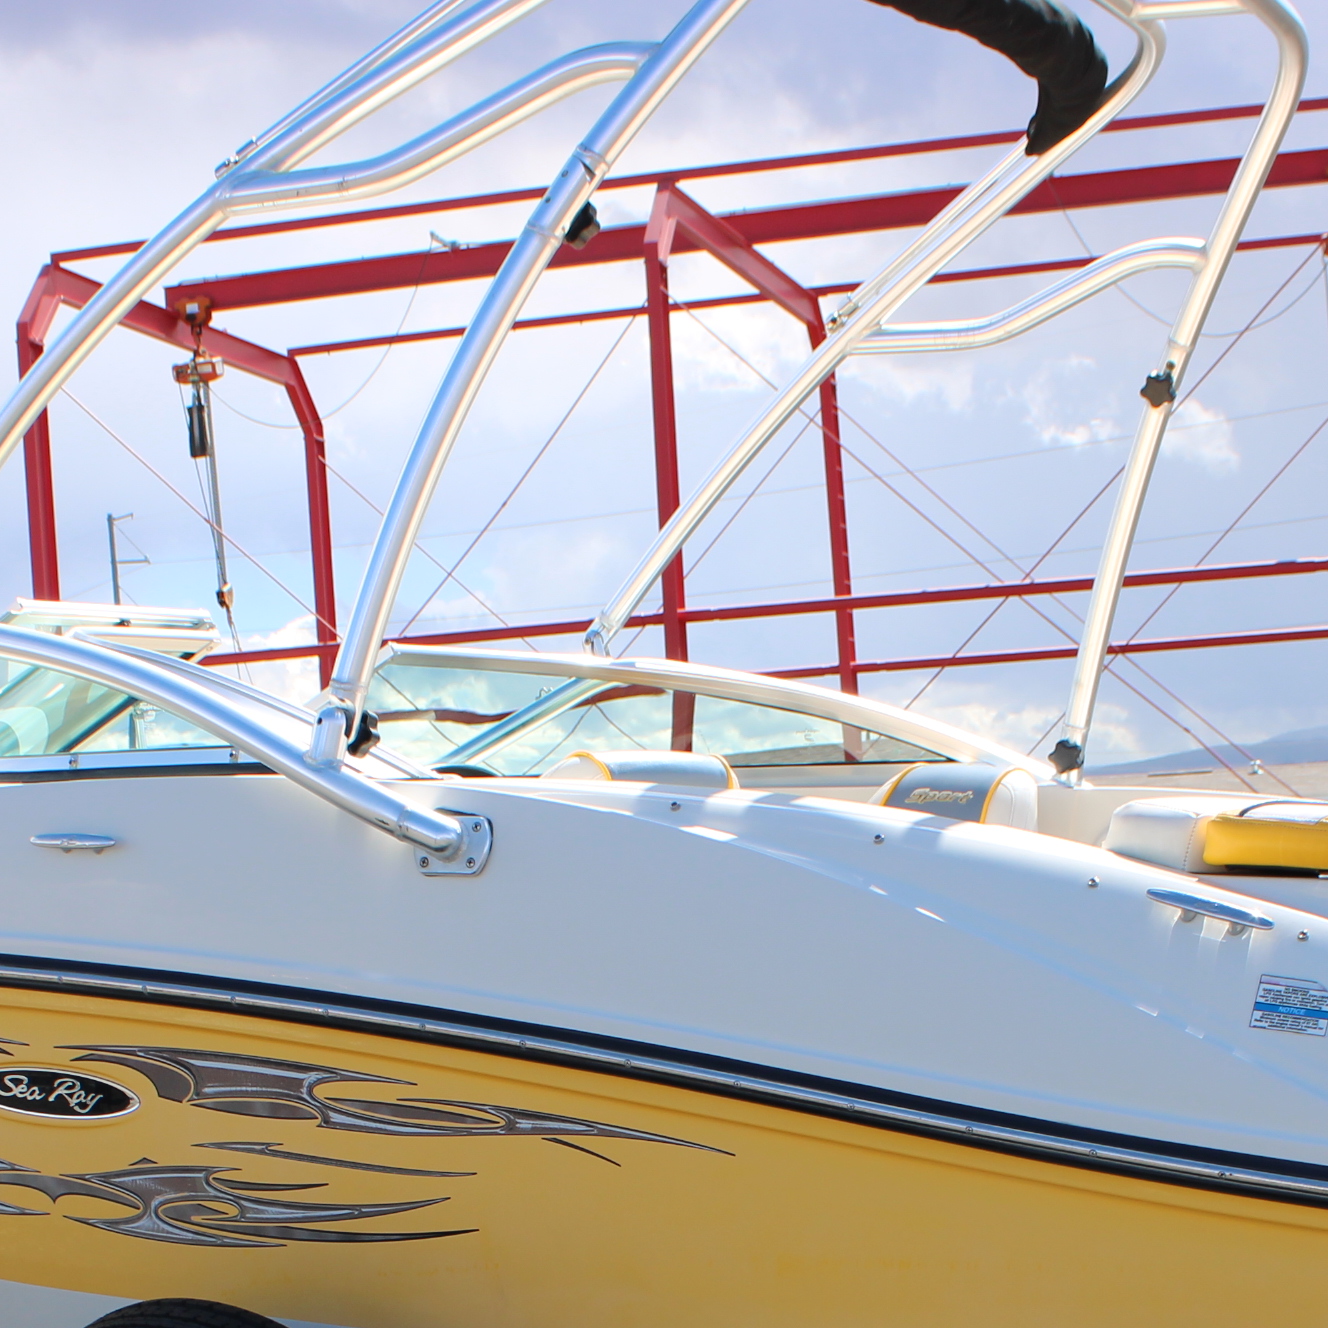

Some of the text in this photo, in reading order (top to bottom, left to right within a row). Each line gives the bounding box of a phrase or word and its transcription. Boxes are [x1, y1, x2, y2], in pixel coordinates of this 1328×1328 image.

[904, 787, 974, 805] Sport
[1277, 1006, 1307, 1016] NOTICE
[47, 1077, 104, 1114] Ray
